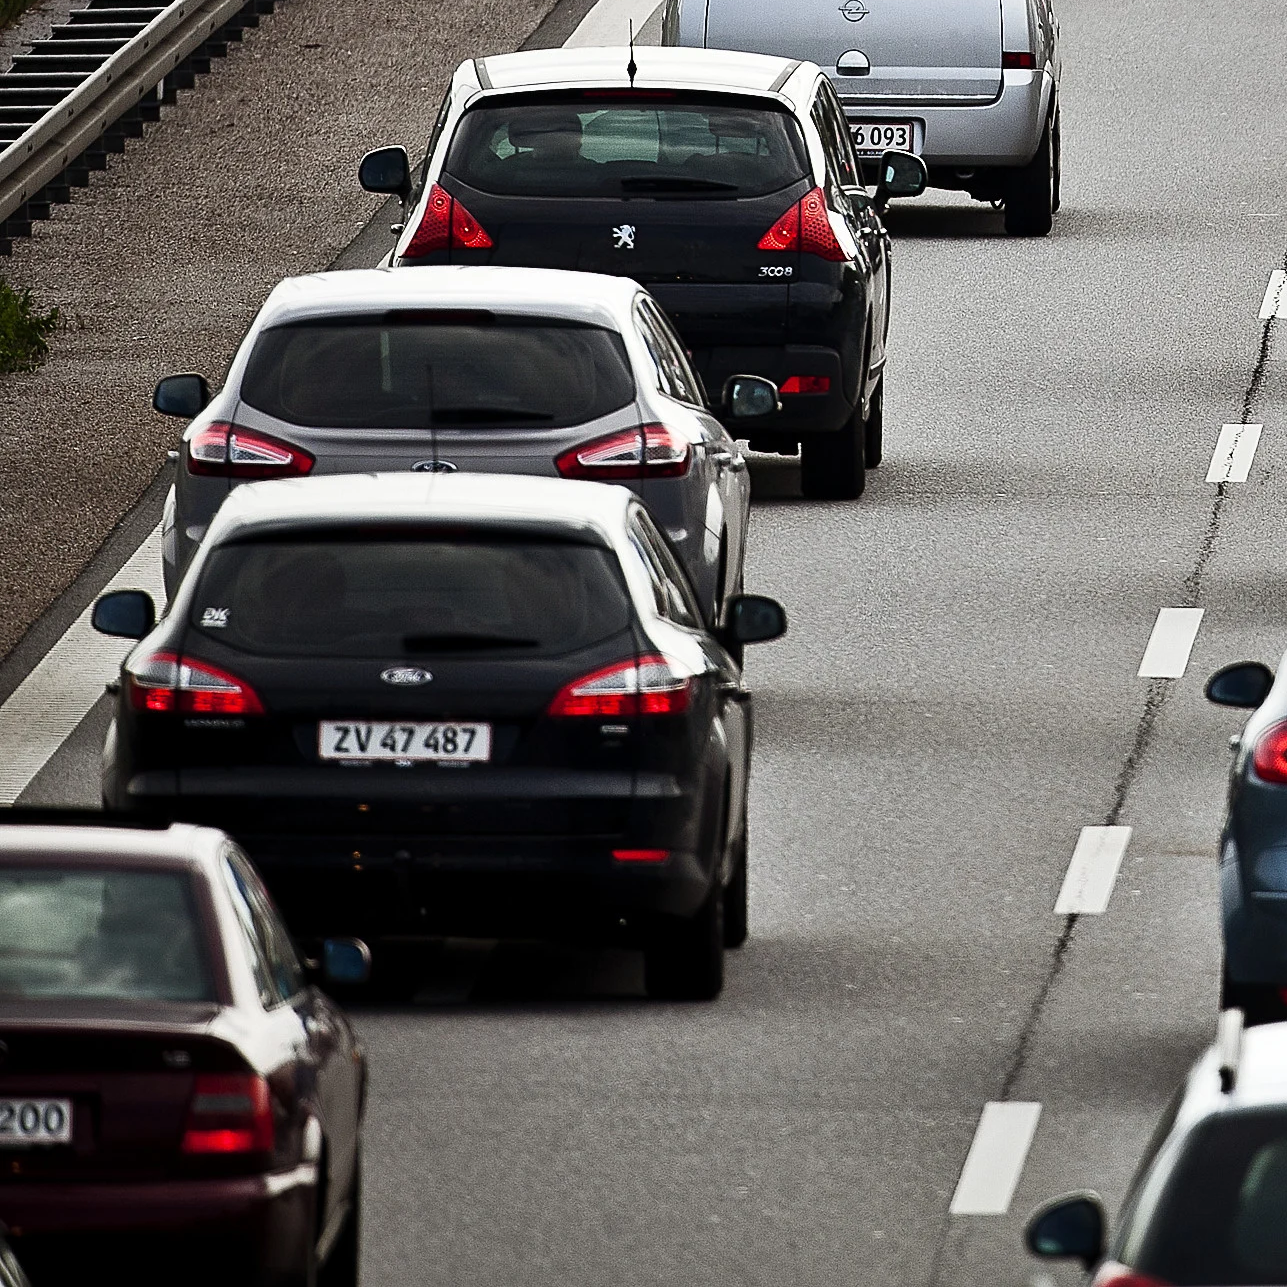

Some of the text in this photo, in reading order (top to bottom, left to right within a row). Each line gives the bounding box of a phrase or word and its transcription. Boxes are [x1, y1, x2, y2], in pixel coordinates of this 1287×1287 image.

[870, 127, 907, 147] 093
[758, 266, 793, 277] 3008
[333, 725, 477, 754] ZV 47 487
